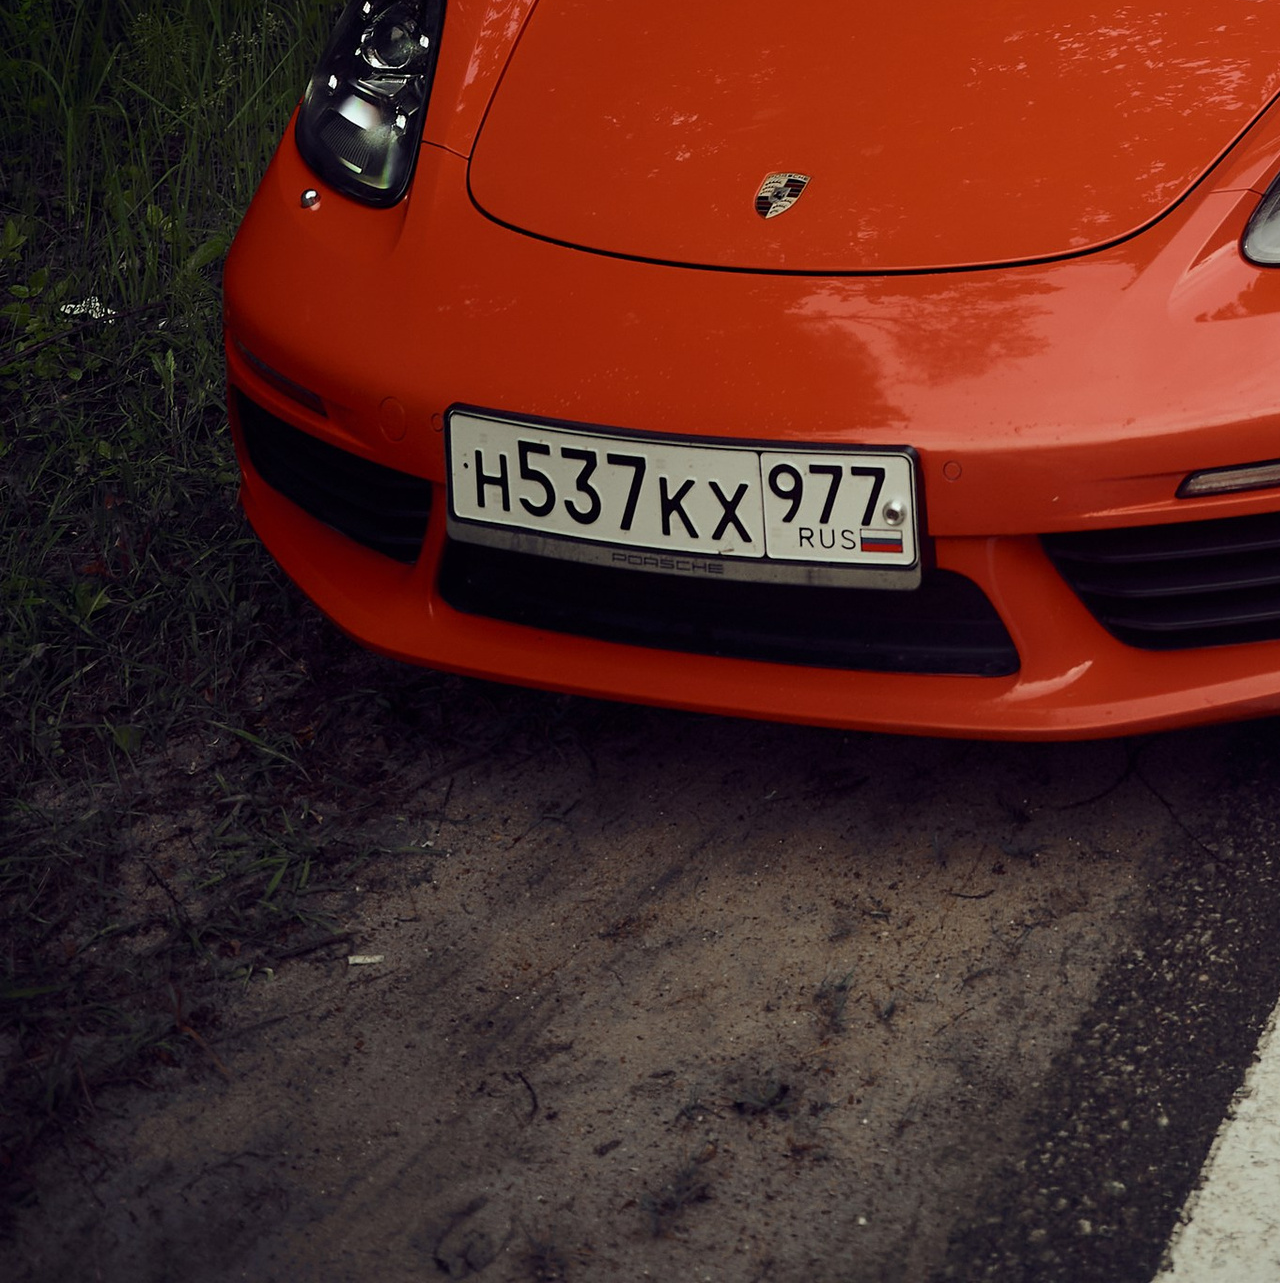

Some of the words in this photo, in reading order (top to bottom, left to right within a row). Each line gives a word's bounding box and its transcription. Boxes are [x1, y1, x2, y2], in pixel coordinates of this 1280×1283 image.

[767, 462, 887, 526] 977
[799, 527, 857, 550] RUS
[612, 553, 724, 574] PORSCHE
